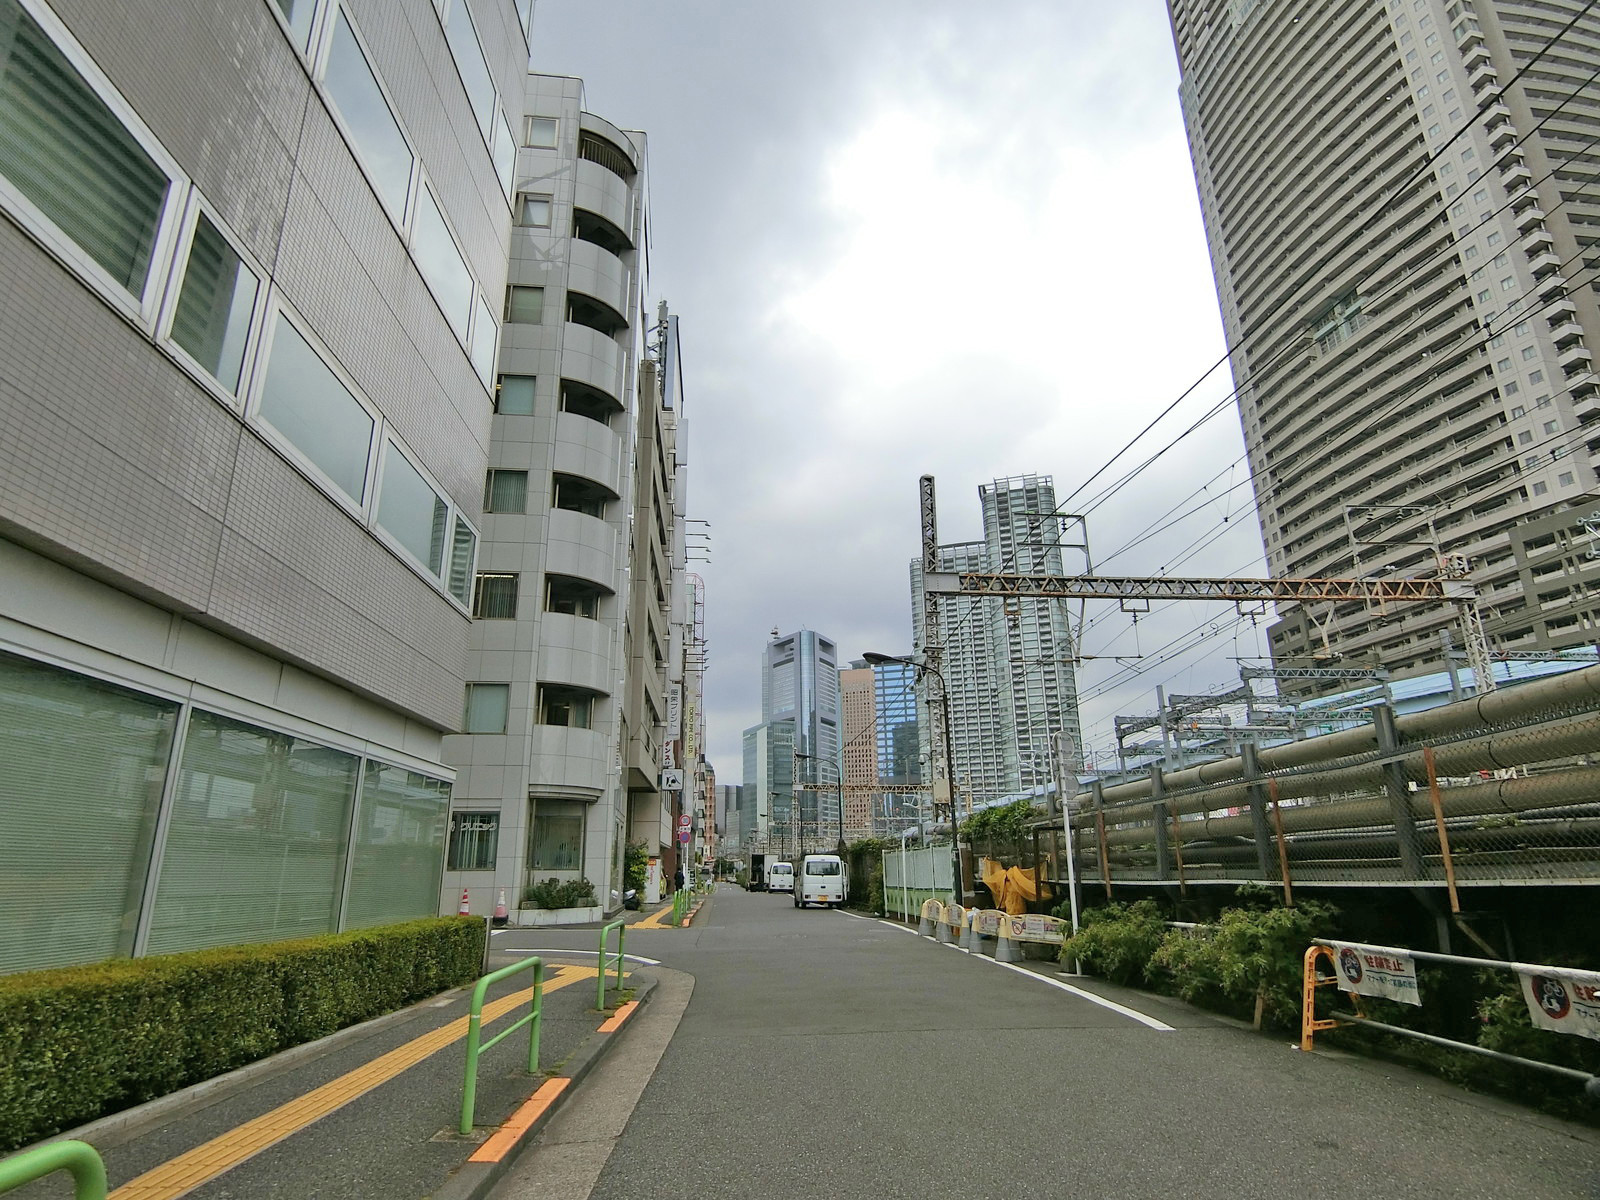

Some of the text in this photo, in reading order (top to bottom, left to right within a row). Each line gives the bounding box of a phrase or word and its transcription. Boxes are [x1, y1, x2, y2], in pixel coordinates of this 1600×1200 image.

[460, 822, 497, 831] クリニック
